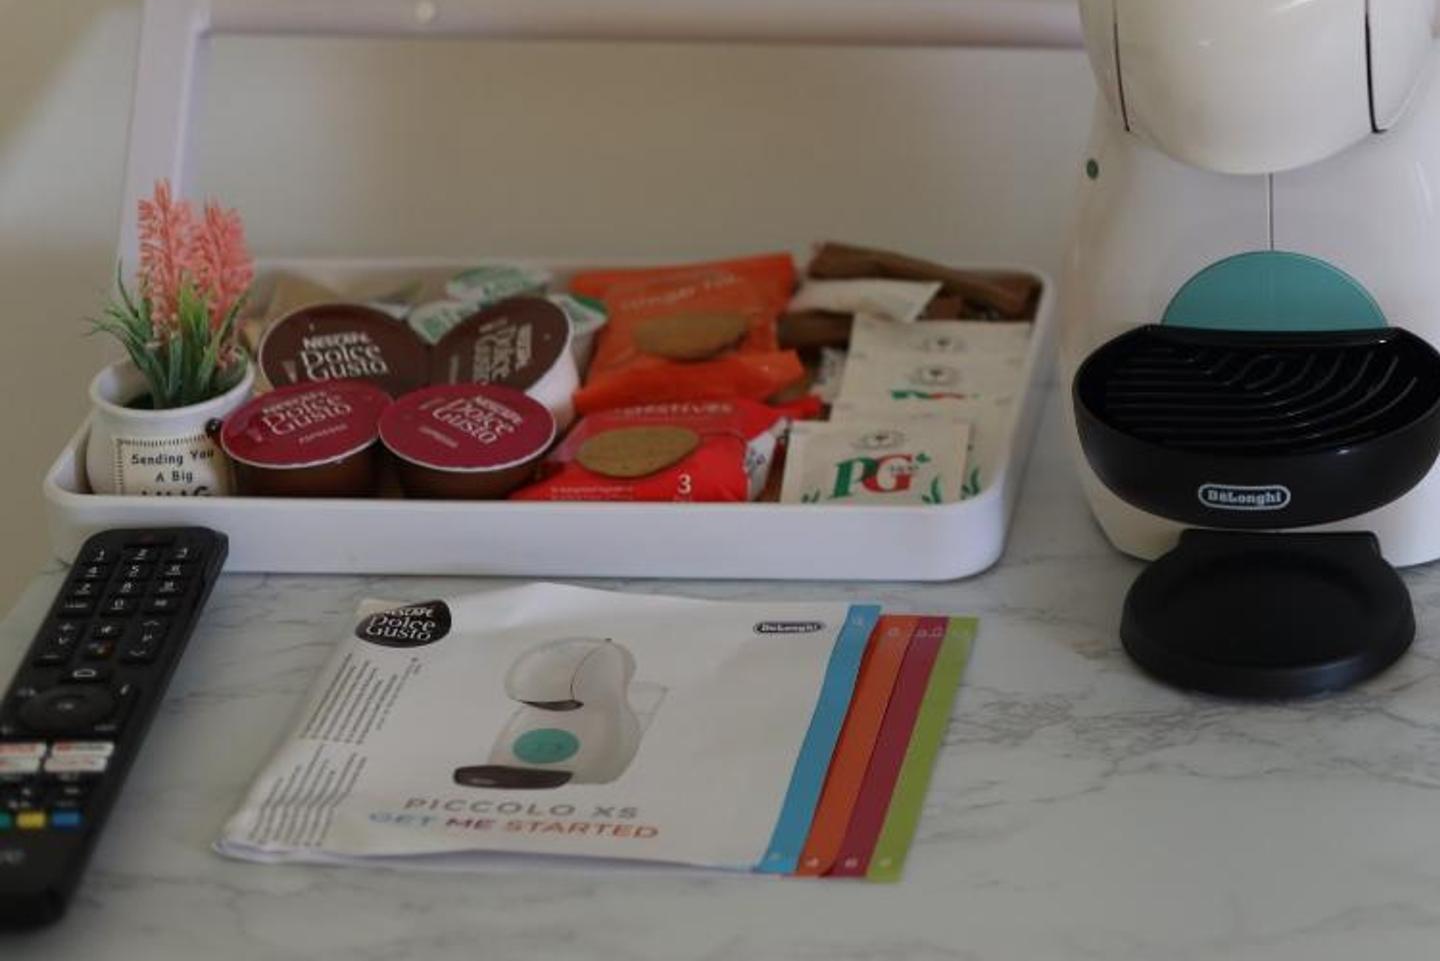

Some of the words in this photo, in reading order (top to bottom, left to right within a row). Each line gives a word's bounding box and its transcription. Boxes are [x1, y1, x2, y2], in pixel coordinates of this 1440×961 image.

[301, 343, 381, 369] Dolce
[306, 359, 388, 382] Gusto
[131, 453, 184, 465] Sending
[190, 449, 214, 460] You
[156, 471, 165, 482] A
[171, 470, 194, 483] Big
[678, 473, 692, 494] 3
[828, 452, 914, 500] PG
[365, 625, 432, 640] Gusto
[370, 616, 437, 632] Dolce
[403, 797, 577, 817] PICCOLO
[591, 805, 639, 819] XS
[368, 811, 435, 827] GET
[445, 817, 497, 830] ME
[503, 819, 661, 839] STARTED
